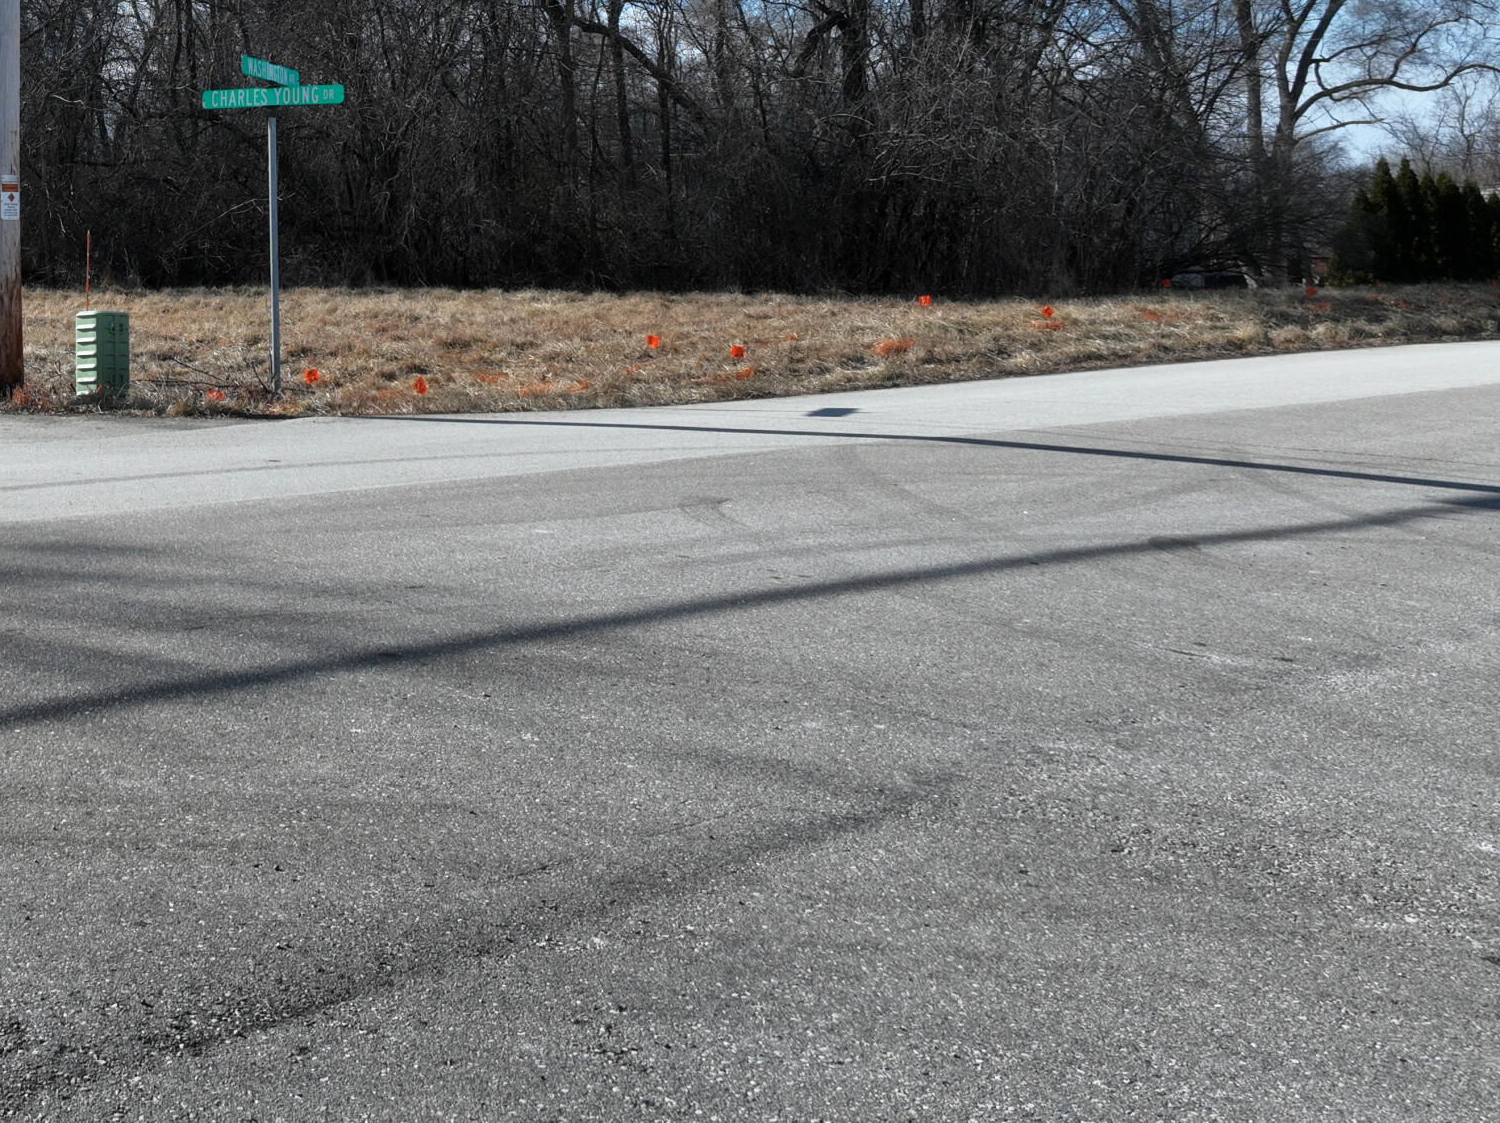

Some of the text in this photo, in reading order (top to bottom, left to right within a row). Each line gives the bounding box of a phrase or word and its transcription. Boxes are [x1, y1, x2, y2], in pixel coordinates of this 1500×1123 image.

[247, 58, 288, 84] WASHINGTON
[212, 86, 334, 107] CHARLES YOUNG DR
